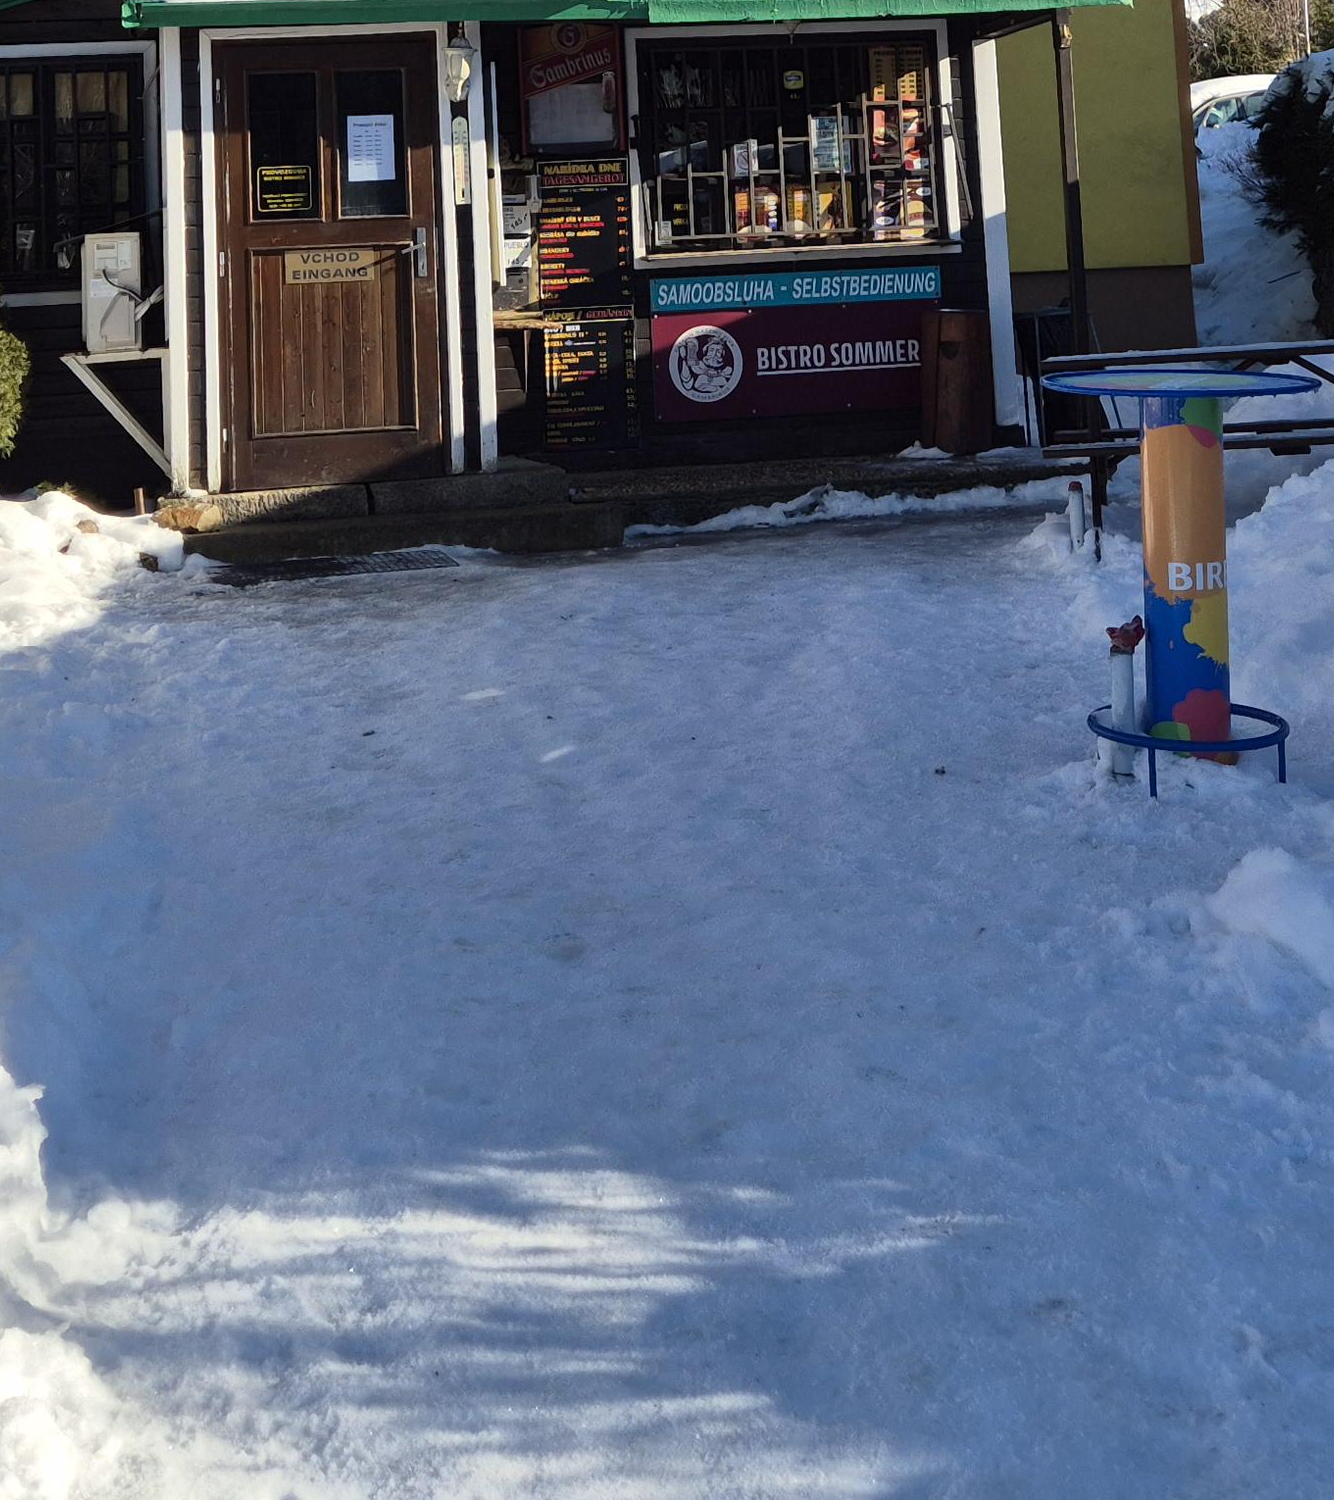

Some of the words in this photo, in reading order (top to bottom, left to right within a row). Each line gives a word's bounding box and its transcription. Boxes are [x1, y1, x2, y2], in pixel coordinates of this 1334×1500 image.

[530, 48, 612, 88] Gambrinus
[599, 163, 622, 173] DNE
[300, 252, 360, 264] VCHOD
[292, 267, 368, 280] EINGANG
[657, 280, 774, 306] SAMOOBSLUHA
[792, 273, 936, 299] SELBSTBEDIENUNG
[757, 345, 825, 370] BISTRO
[831, 339, 921, 367] SOMMER
